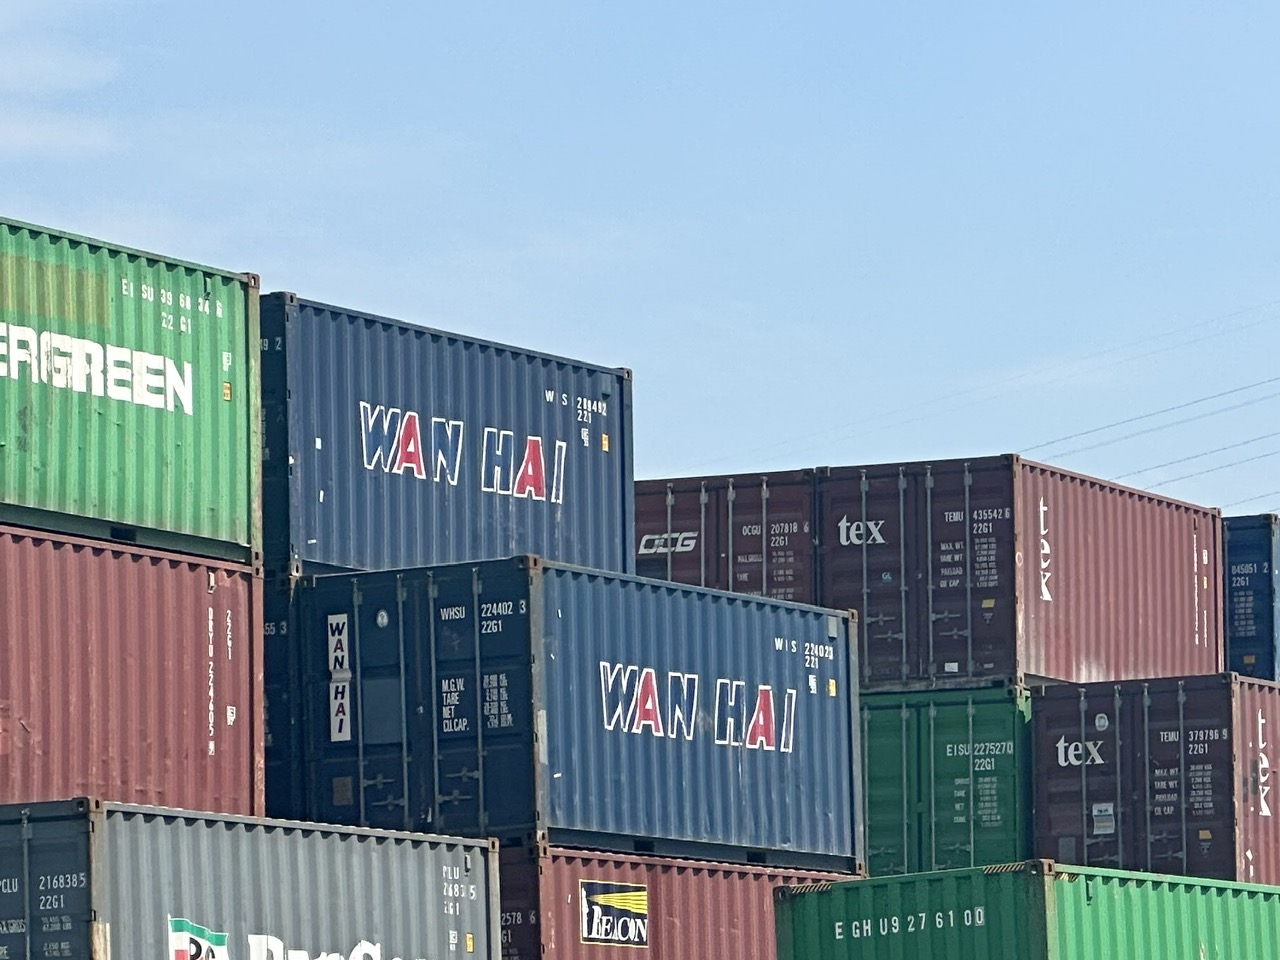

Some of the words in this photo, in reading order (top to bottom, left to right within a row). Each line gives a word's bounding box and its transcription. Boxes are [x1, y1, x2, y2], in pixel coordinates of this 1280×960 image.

[0, 322, 193, 416] RGREEN
[359, 400, 464, 486] WAN
[481, 427, 567, 504] HAI
[944, 511, 964, 522] TEMU
[973, 508, 1002, 520] 435542
[1004, 508, 1011, 519] 6
[770, 522, 798, 534] 207818
[837, 515, 886, 546] tex
[972, 522, 993, 534] 22G1
[638, 531, 699, 554] OCG
[770, 536, 789, 547] 22G1
[1039, 496, 1053, 601] tex
[1231, 576, 1250, 587] 22G1
[440, 606, 466, 621] WHSU
[481, 602, 513, 618] 224402
[519, 600, 527, 614] 3
[481, 621, 503, 634] 22G1
[330, 622, 346, 670] WAN
[334, 685, 347, 734] HAI
[1160, 731, 1179, 742] TEMU
[1188, 729, 1219, 742] 379796
[1222, 728, 1228, 740] 9
[946, 743, 970, 756] EISU
[1055, 735, 1105, 767] tex
[1188, 743, 1209, 755] 22G1
[974, 758, 995, 771] 22G1
[1258, 708, 1272, 817] tex
[39, 872, 87, 890] 2168385
[468, 885, 477, 900] 5
[39, 895, 64, 910] 22G1
[588, 905, 647, 942] BEACON
